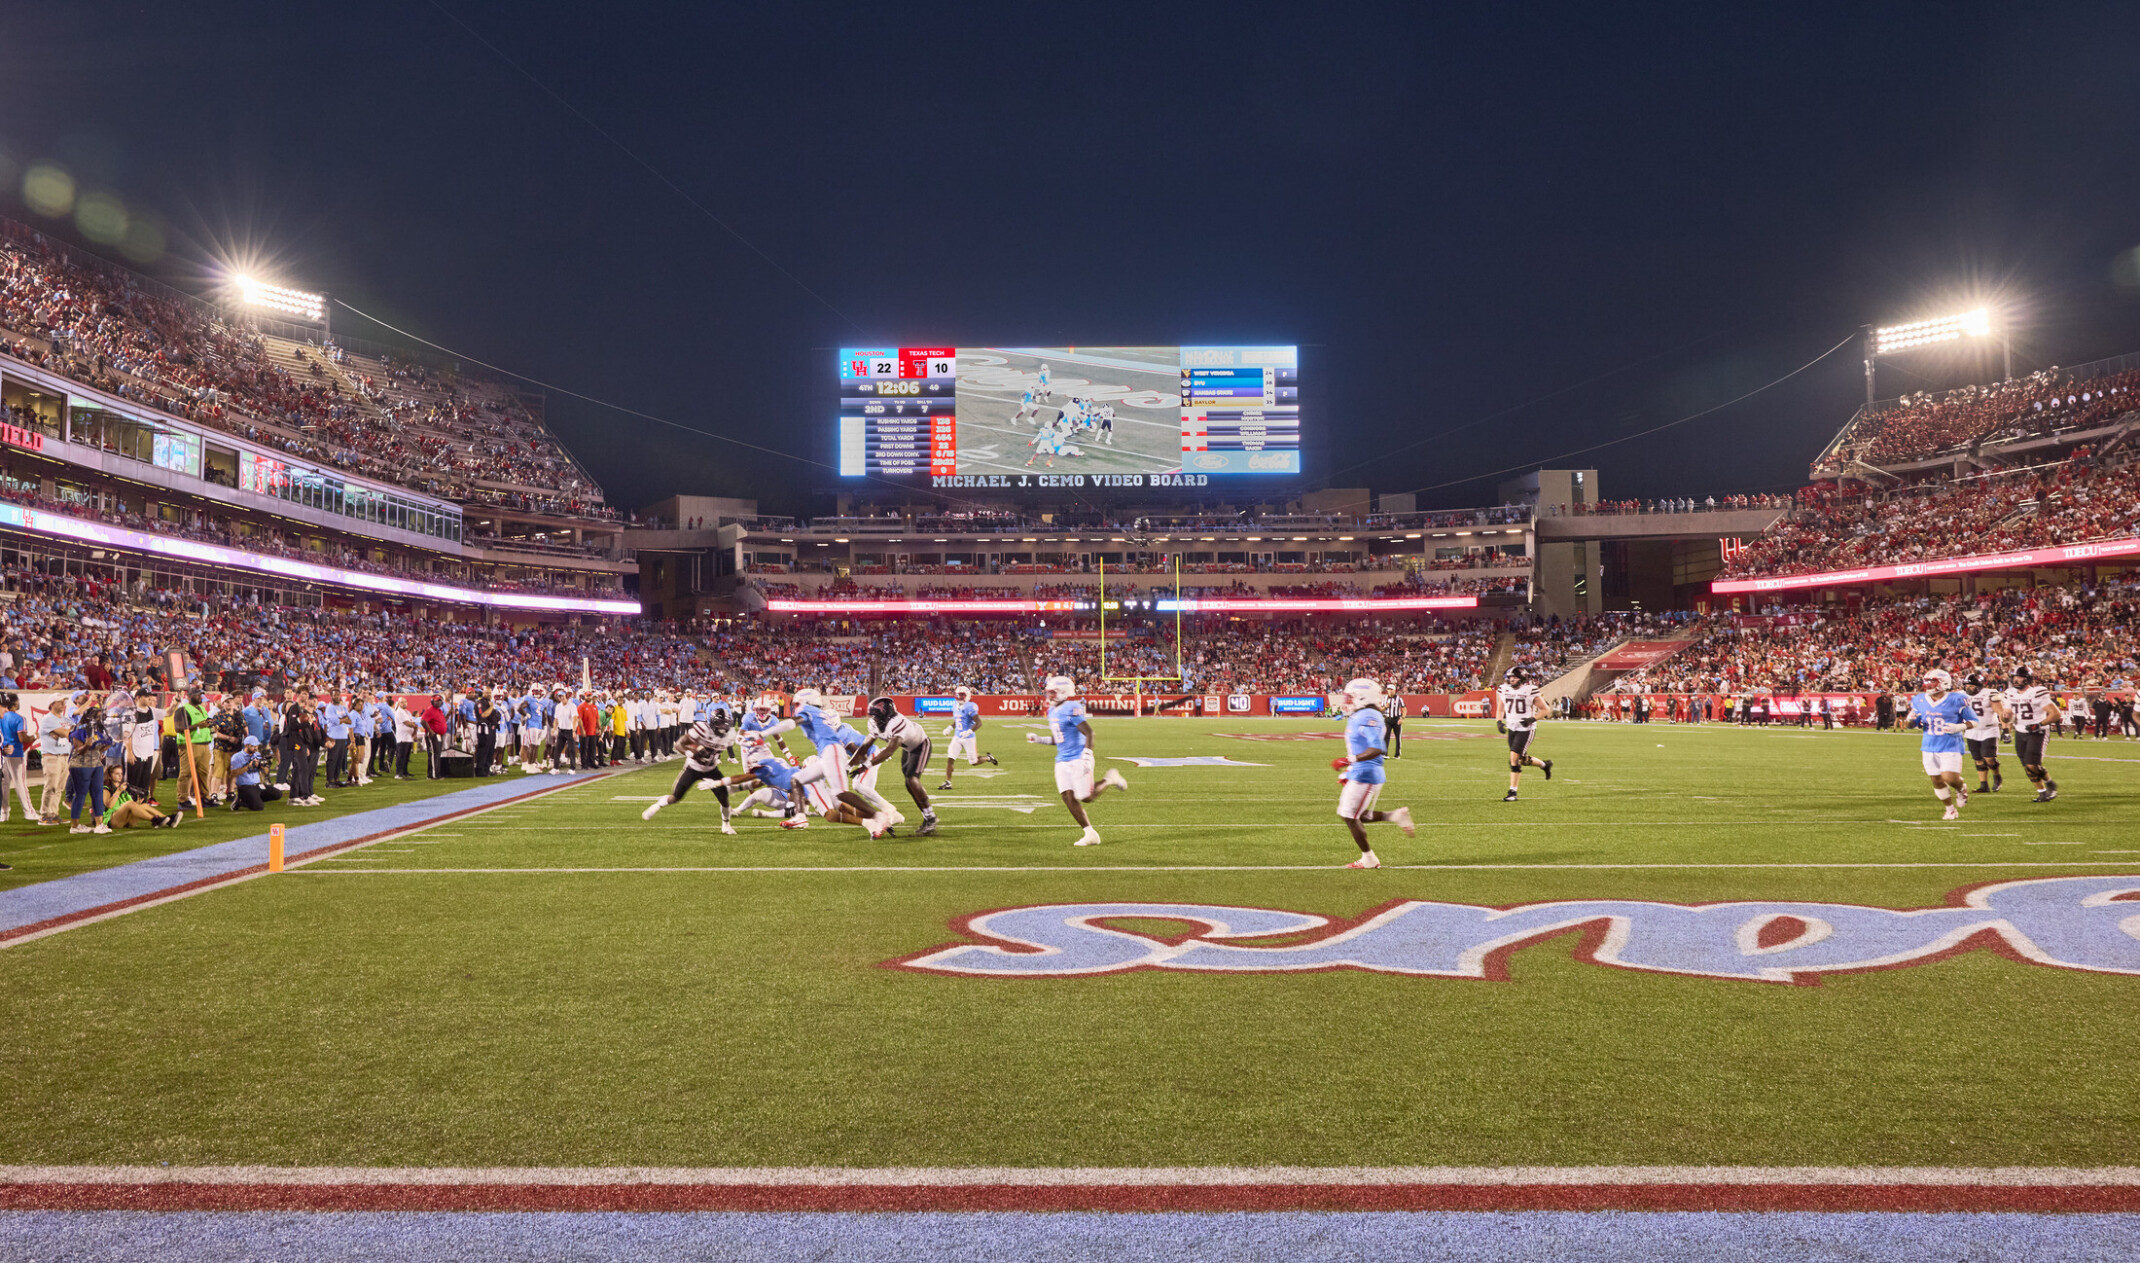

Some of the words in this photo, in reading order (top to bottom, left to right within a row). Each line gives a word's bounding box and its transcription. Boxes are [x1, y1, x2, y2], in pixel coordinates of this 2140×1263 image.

[877, 363, 891, 373] 22
[935, 363, 948, 373] 10
[876, 381, 920, 395] 12:06
[864, 405, 885, 413] 2ND
[896, 405, 903, 413] 7
[921, 405, 928, 413] 7
[933, 475, 1011, 488] MICHAEL
[1018, 475, 1032, 488] J.
[1039, 475, 1084, 487] CEMO
[1092, 475, 1143, 487] VIDEO
[1150, 474, 1208, 486] BOARD
[22, 508, 34, 529] UH
[2063, 545, 2099, 558] TDECU
[1895, 564, 1924, 576] TDECU
[1755, 579, 1783, 589] TDECU
[1146, 699, 1194, 710] FELD
[1231, 698, 1248, 709] 40
[1505, 698, 1527, 714] 70
[1971, 701, 1984, 717] 5
[1926, 717, 1945, 735] 18
